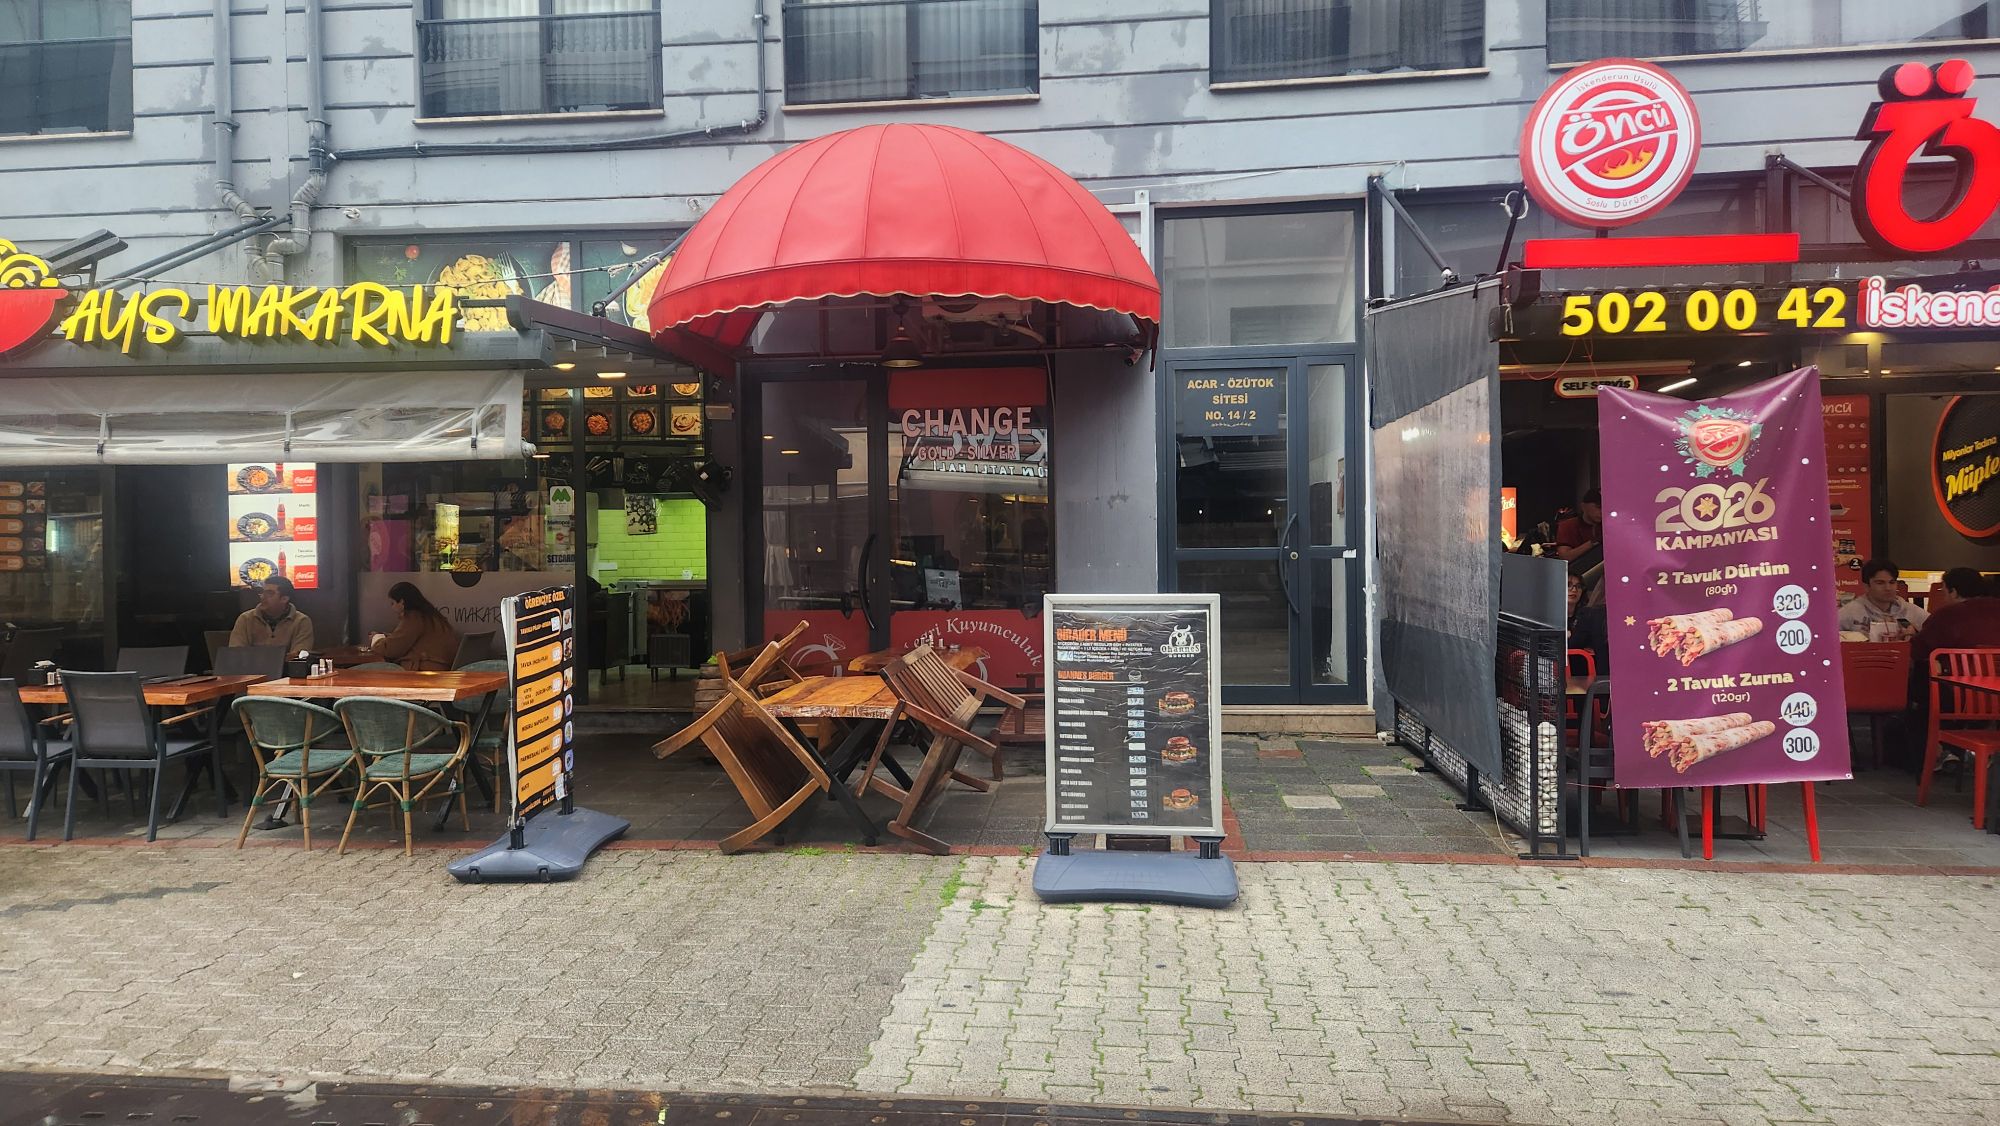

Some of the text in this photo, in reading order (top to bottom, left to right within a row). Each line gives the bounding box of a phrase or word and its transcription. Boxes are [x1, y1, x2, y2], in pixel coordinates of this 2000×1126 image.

[1576, 73, 1629, 93] İskenderun
[1614, 194, 1649, 208] Dürüm
[207, 282, 458, 346] MAKARNA
[1562, 287, 1846, 336] 502 00 42
[1187, 379, 1218, 389] ACAR
[1227, 377, 1274, 388] ÖZÜTOK
[1562, 382, 1588, 391] SELF
[1212, 392, 1248, 404] SİTESİ
[901, 407, 1032, 438] CHANGE
[1205, 411, 1224, 420] NO.
[1228, 410, 1240, 420] 14
[1249, 410, 1256, 419] 2
[918, 446, 955, 461] GOLD
[968, 444, 1016, 460] SILVER
[1655, 478, 1776, 532] 2026
[1656, 526, 1778, 551] KAMPANYASI
[1657, 562, 1790, 585] 2 Tavuk Dürüm
[1705, 584, 1738, 598] (80gr)
[946, 616, 1041, 668] Kuyumculuk
[1667, 672, 1794, 692] 2 Tavuk Zurna
[1711, 692, 1750, 704] (120gr)
